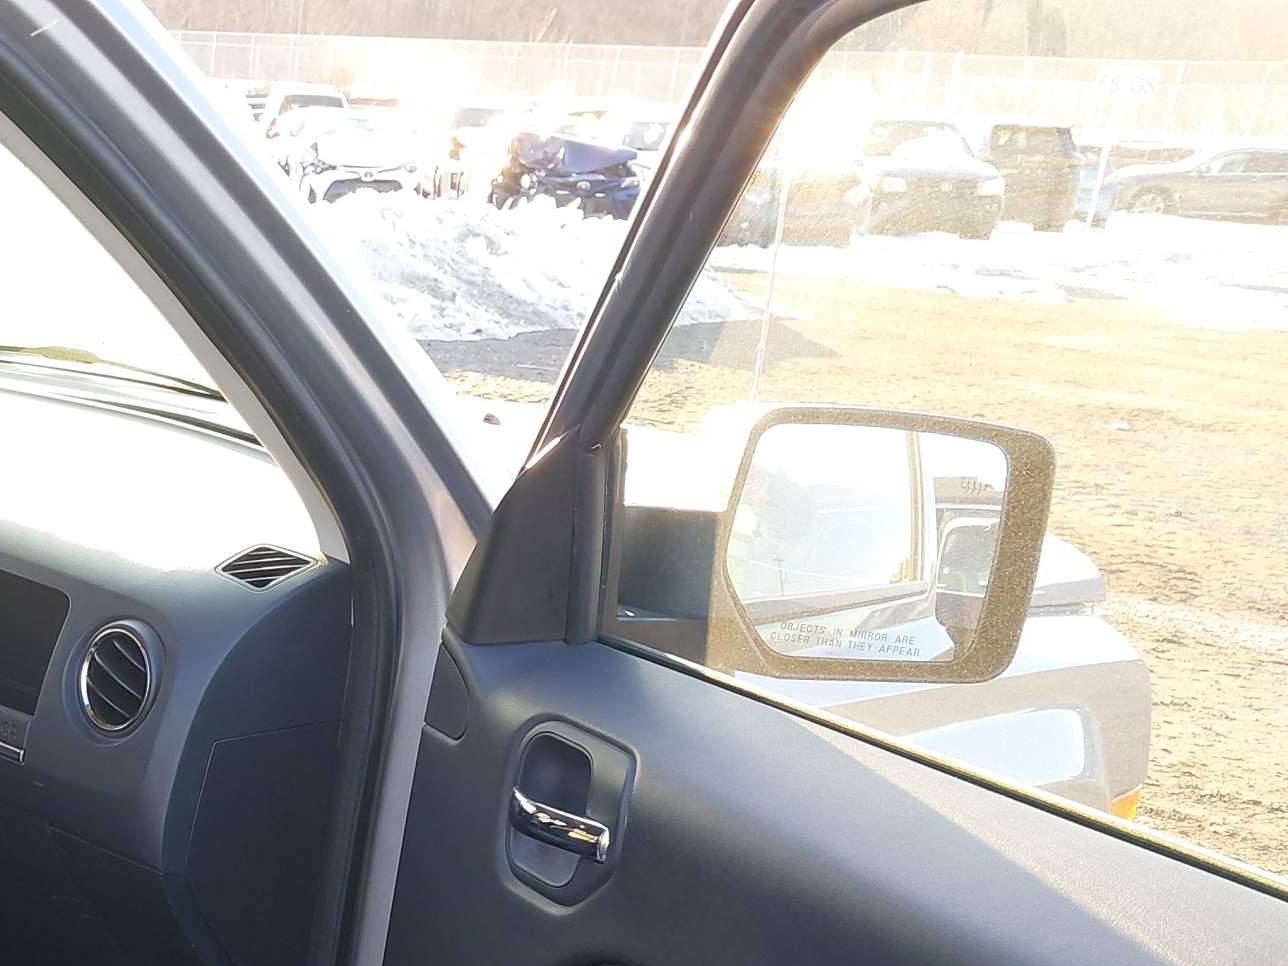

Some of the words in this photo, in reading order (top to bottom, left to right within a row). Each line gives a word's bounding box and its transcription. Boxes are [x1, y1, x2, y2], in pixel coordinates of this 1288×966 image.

[770, 631, 810, 644] CLOSER
[815, 637, 842, 647] THAN
[848, 641, 872, 651] THEY
[878, 644, 920, 656] APPEAR
[780, 622, 826, 635] OBJECTS
[833, 628, 843, 637] IN
[849, 629, 887, 642] MIRROR
[895, 634, 915, 645] ARE
